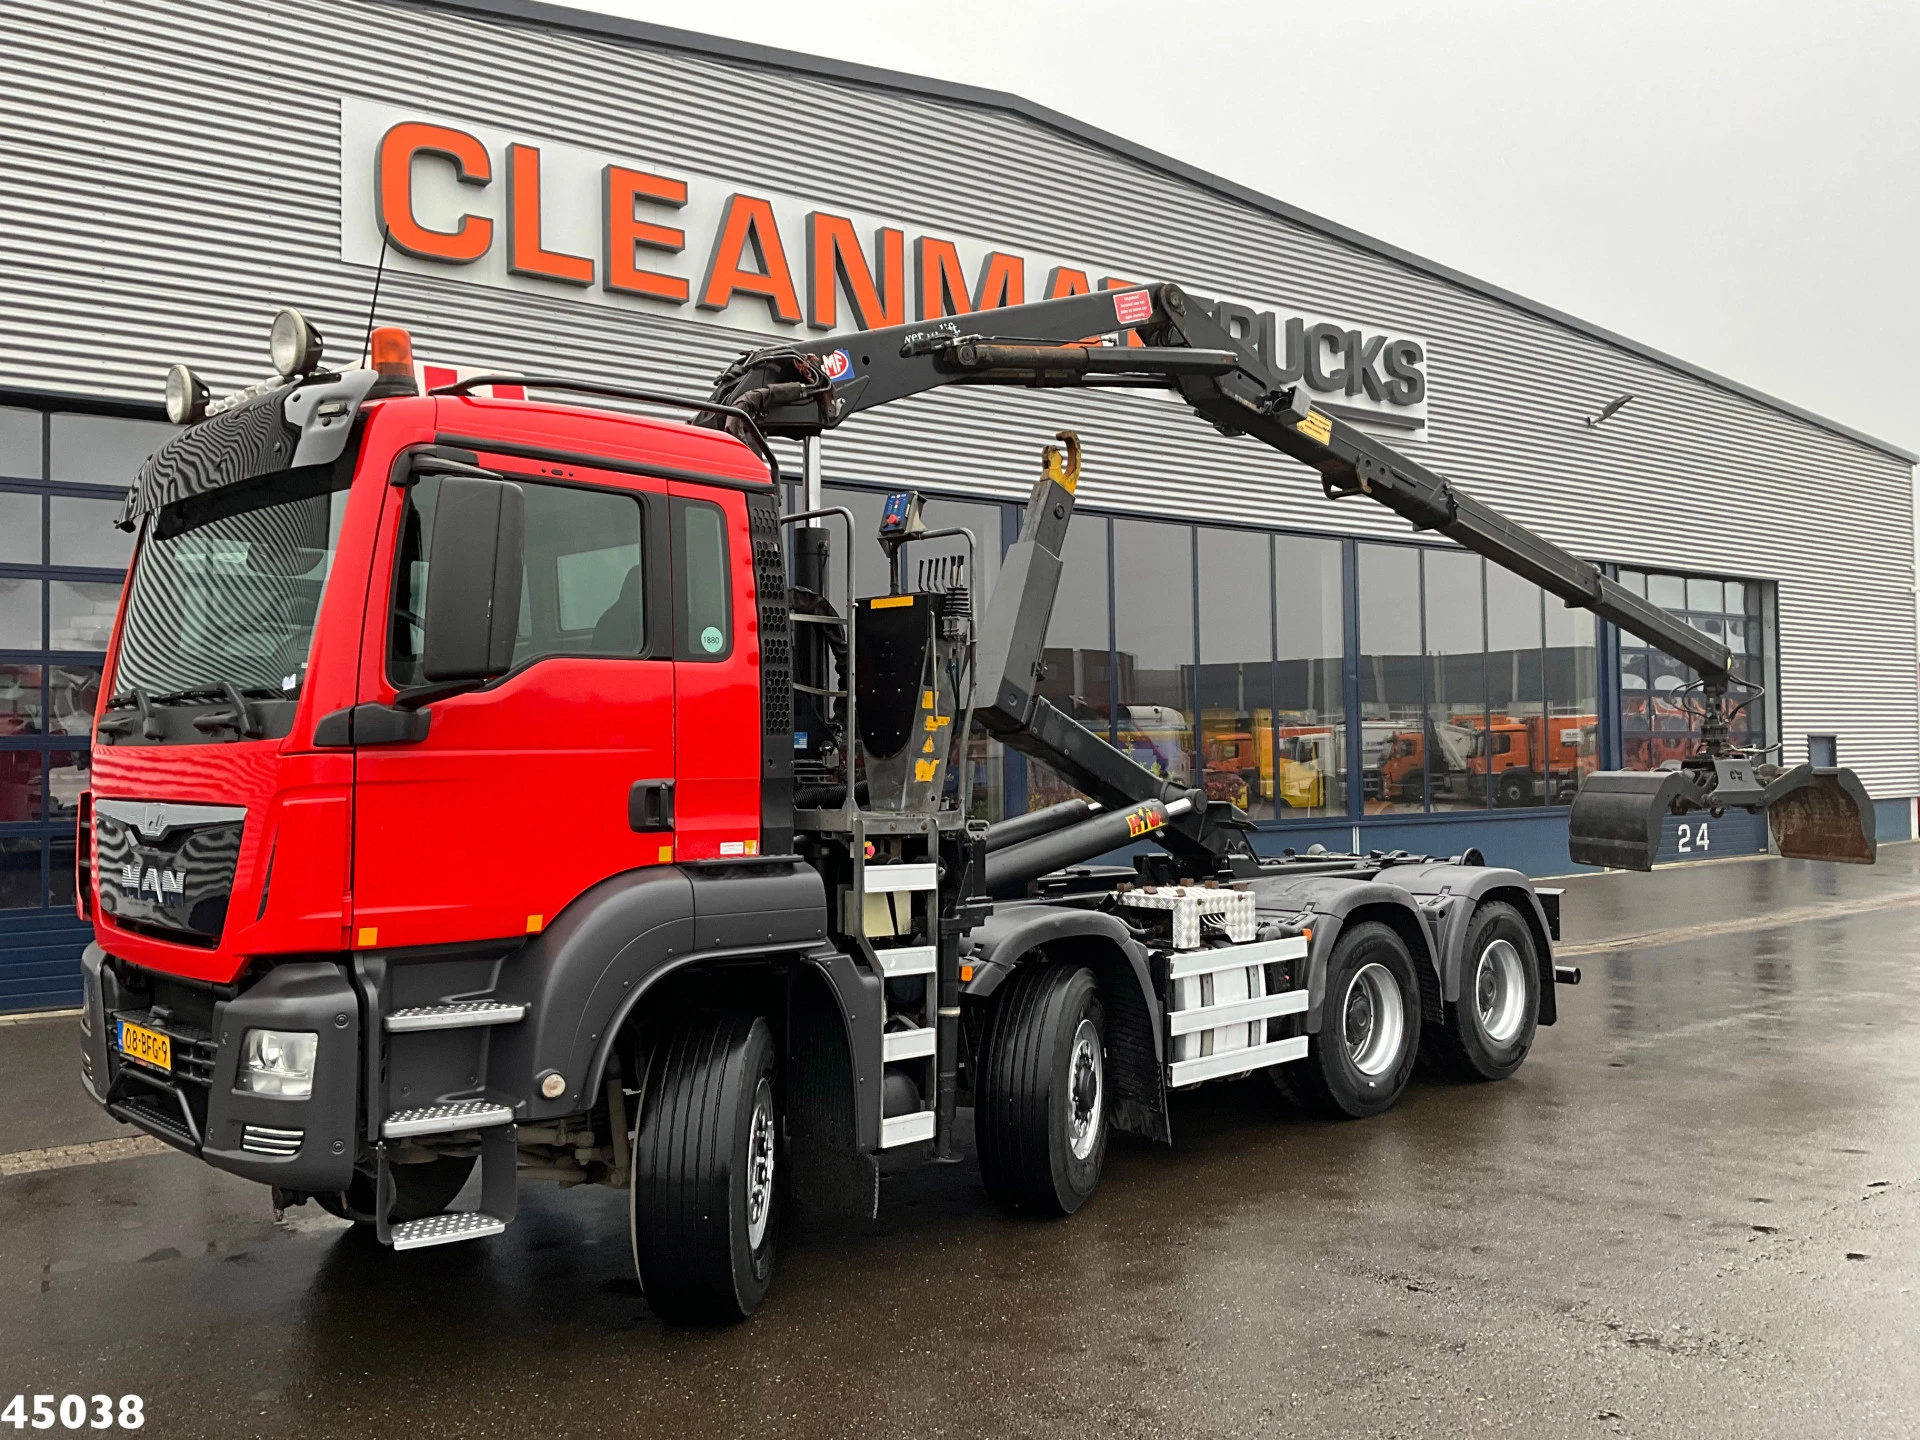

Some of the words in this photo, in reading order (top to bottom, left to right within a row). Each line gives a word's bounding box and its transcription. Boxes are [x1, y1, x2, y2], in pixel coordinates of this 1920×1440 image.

[374, 120, 1145, 348] CLEANMA
[1190, 293, 1426, 406] RUCKS
[703, 636, 720, 645] 1880
[1678, 822, 1710, 853] 24
[121, 864, 186, 903] MAN
[125, 1027, 168, 1063] 08-BFG-9
